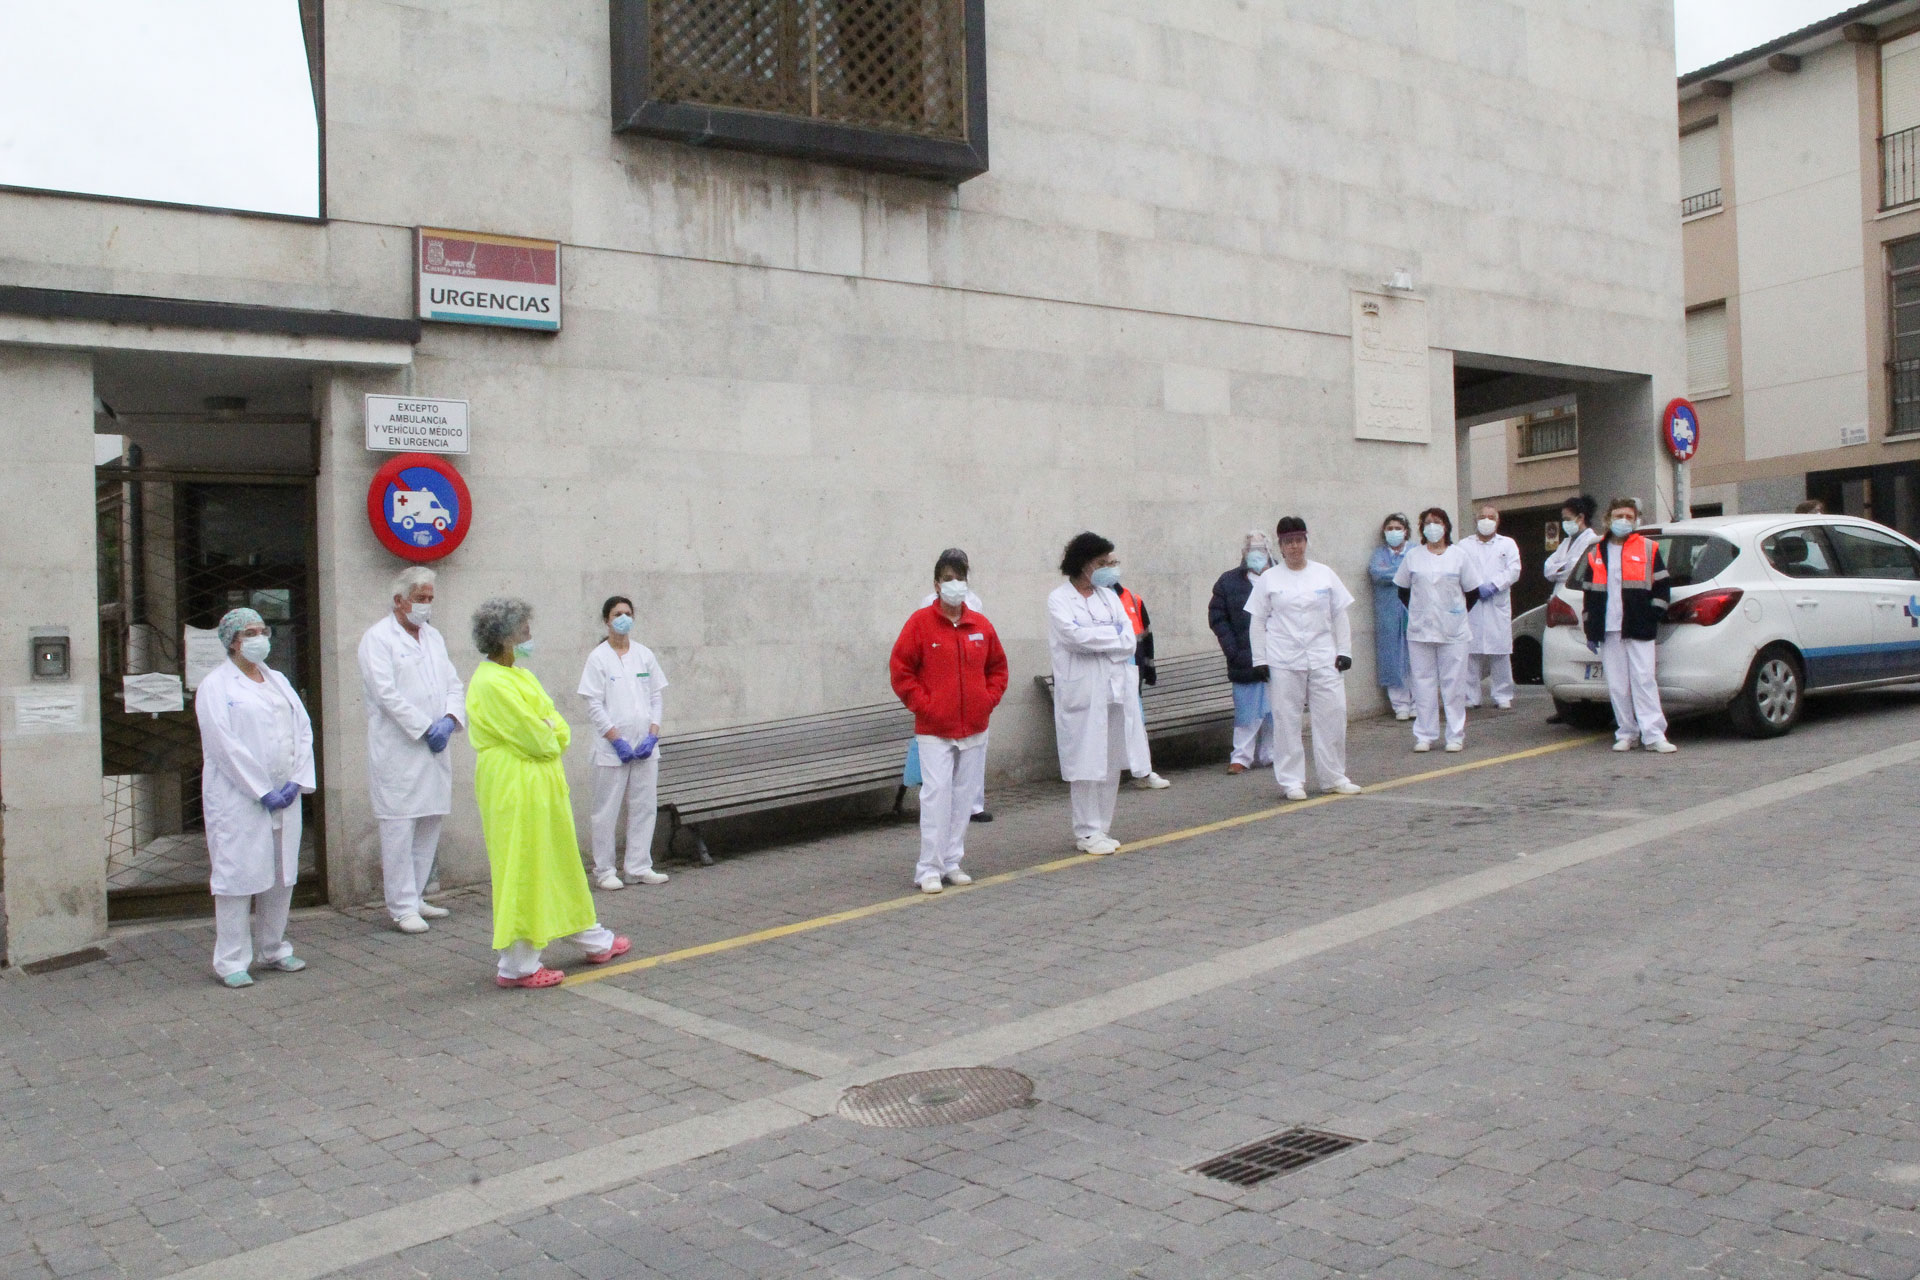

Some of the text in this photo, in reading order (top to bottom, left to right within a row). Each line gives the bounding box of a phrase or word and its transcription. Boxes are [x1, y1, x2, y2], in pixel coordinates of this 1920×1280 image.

[430, 287, 550, 313] URGENCIAS
[398, 403, 439, 413] EXCEPTO
[389, 414, 448, 425] AMBULANCIA
[373, 424, 463, 437] Y VEHÍCULO MÉDICO
[389, 436, 449, 448] EN URGENCIA
